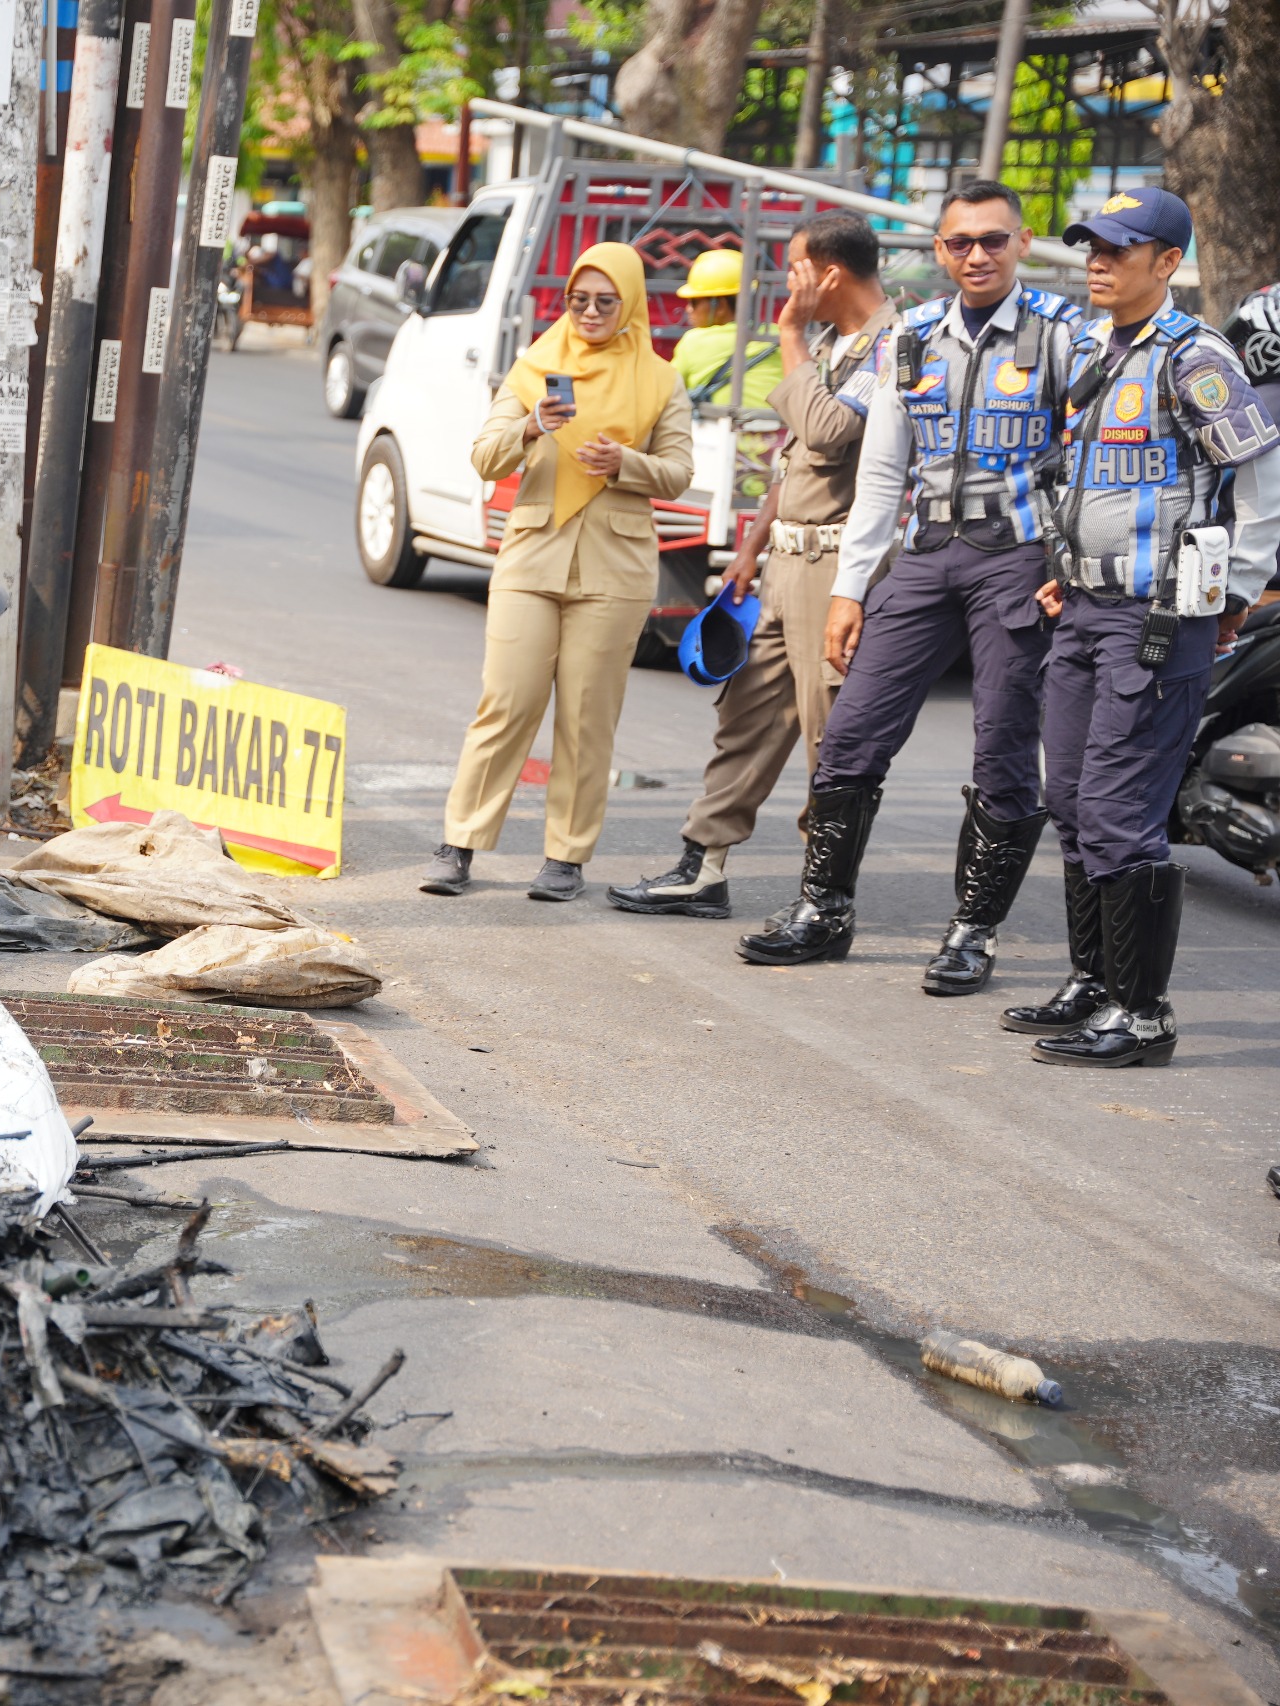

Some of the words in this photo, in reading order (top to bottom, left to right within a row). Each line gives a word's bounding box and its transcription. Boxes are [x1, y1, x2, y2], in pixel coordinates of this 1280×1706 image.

[215, 191, 228, 240] SEDOT
[222, 164, 232, 189] WC
[910, 402, 945, 415] SATRIA
[988, 398, 1031, 411] DISHUB
[973, 414, 1047, 449] HUB
[1103, 429, 1145, 441] DISHUB
[1093, 446, 1167, 485] HUB
[84, 676, 166, 781] ROTI
[175, 698, 289, 809] BAKAR
[303, 728, 342, 818] 77
